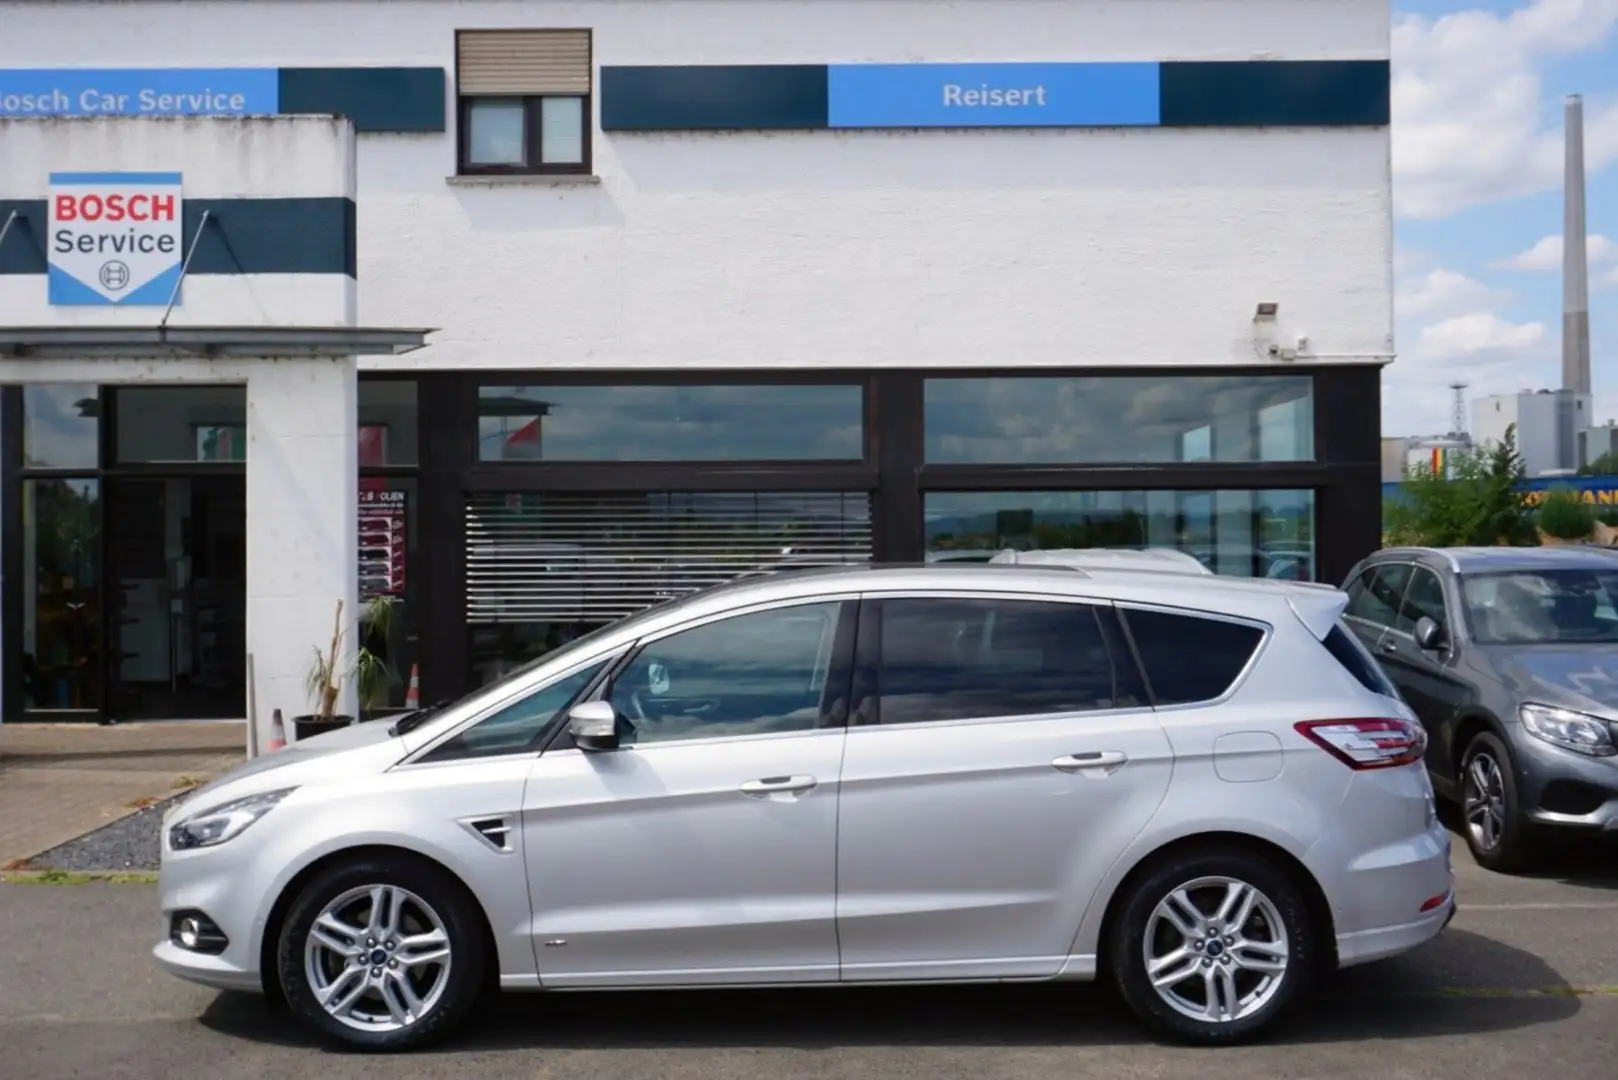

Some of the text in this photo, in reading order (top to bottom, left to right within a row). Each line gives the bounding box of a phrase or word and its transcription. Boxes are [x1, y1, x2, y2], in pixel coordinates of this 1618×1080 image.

[0, 87, 246, 112] osch Car Service
[943, 82, 1047, 107] Reisert
[55, 194, 175, 221] BOSCH
[54, 228, 176, 254] Service
